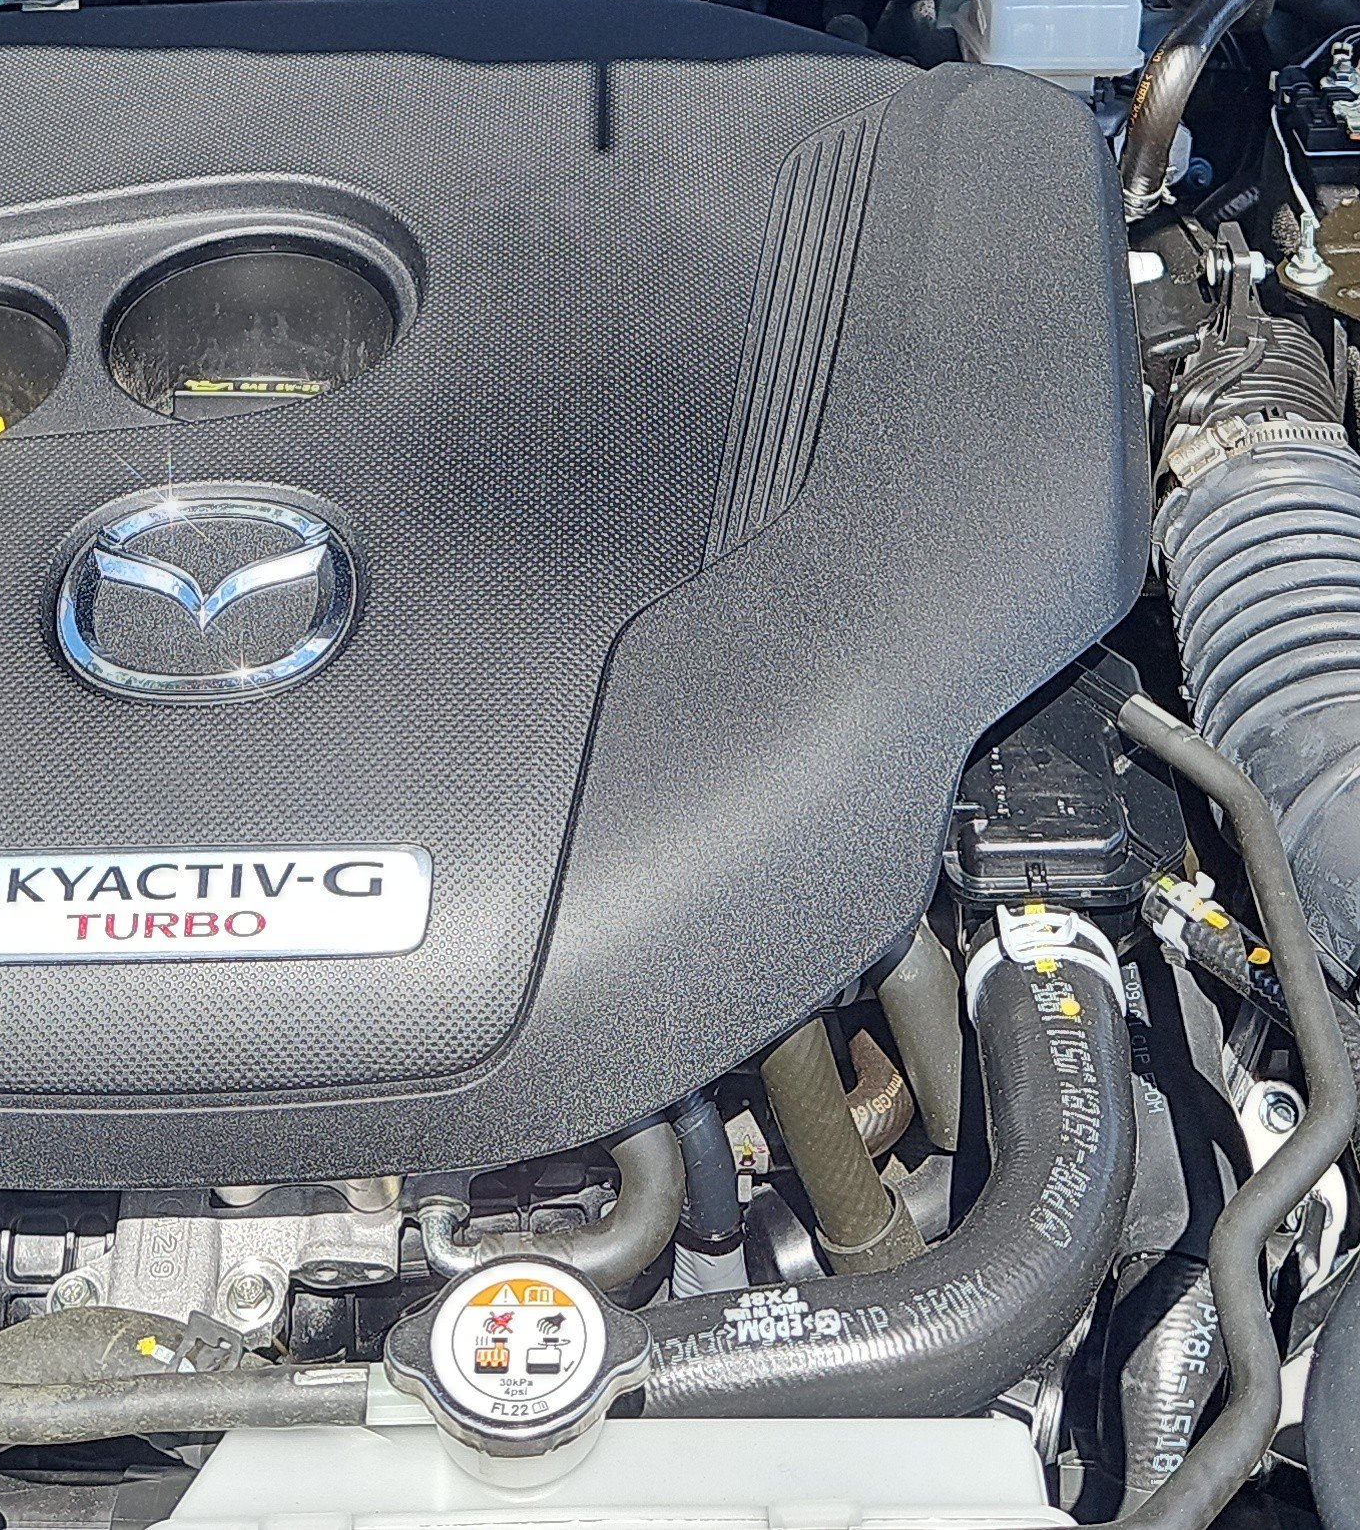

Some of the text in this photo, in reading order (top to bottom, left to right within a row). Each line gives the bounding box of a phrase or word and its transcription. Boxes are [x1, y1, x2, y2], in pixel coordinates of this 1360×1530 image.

[66, 910, 268, 941] TURBO
[499, 1378, 534, 1388] 30kPa
[503, 1387, 529, 1397] 4psi
[490, 1401, 530, 1416] FL22
